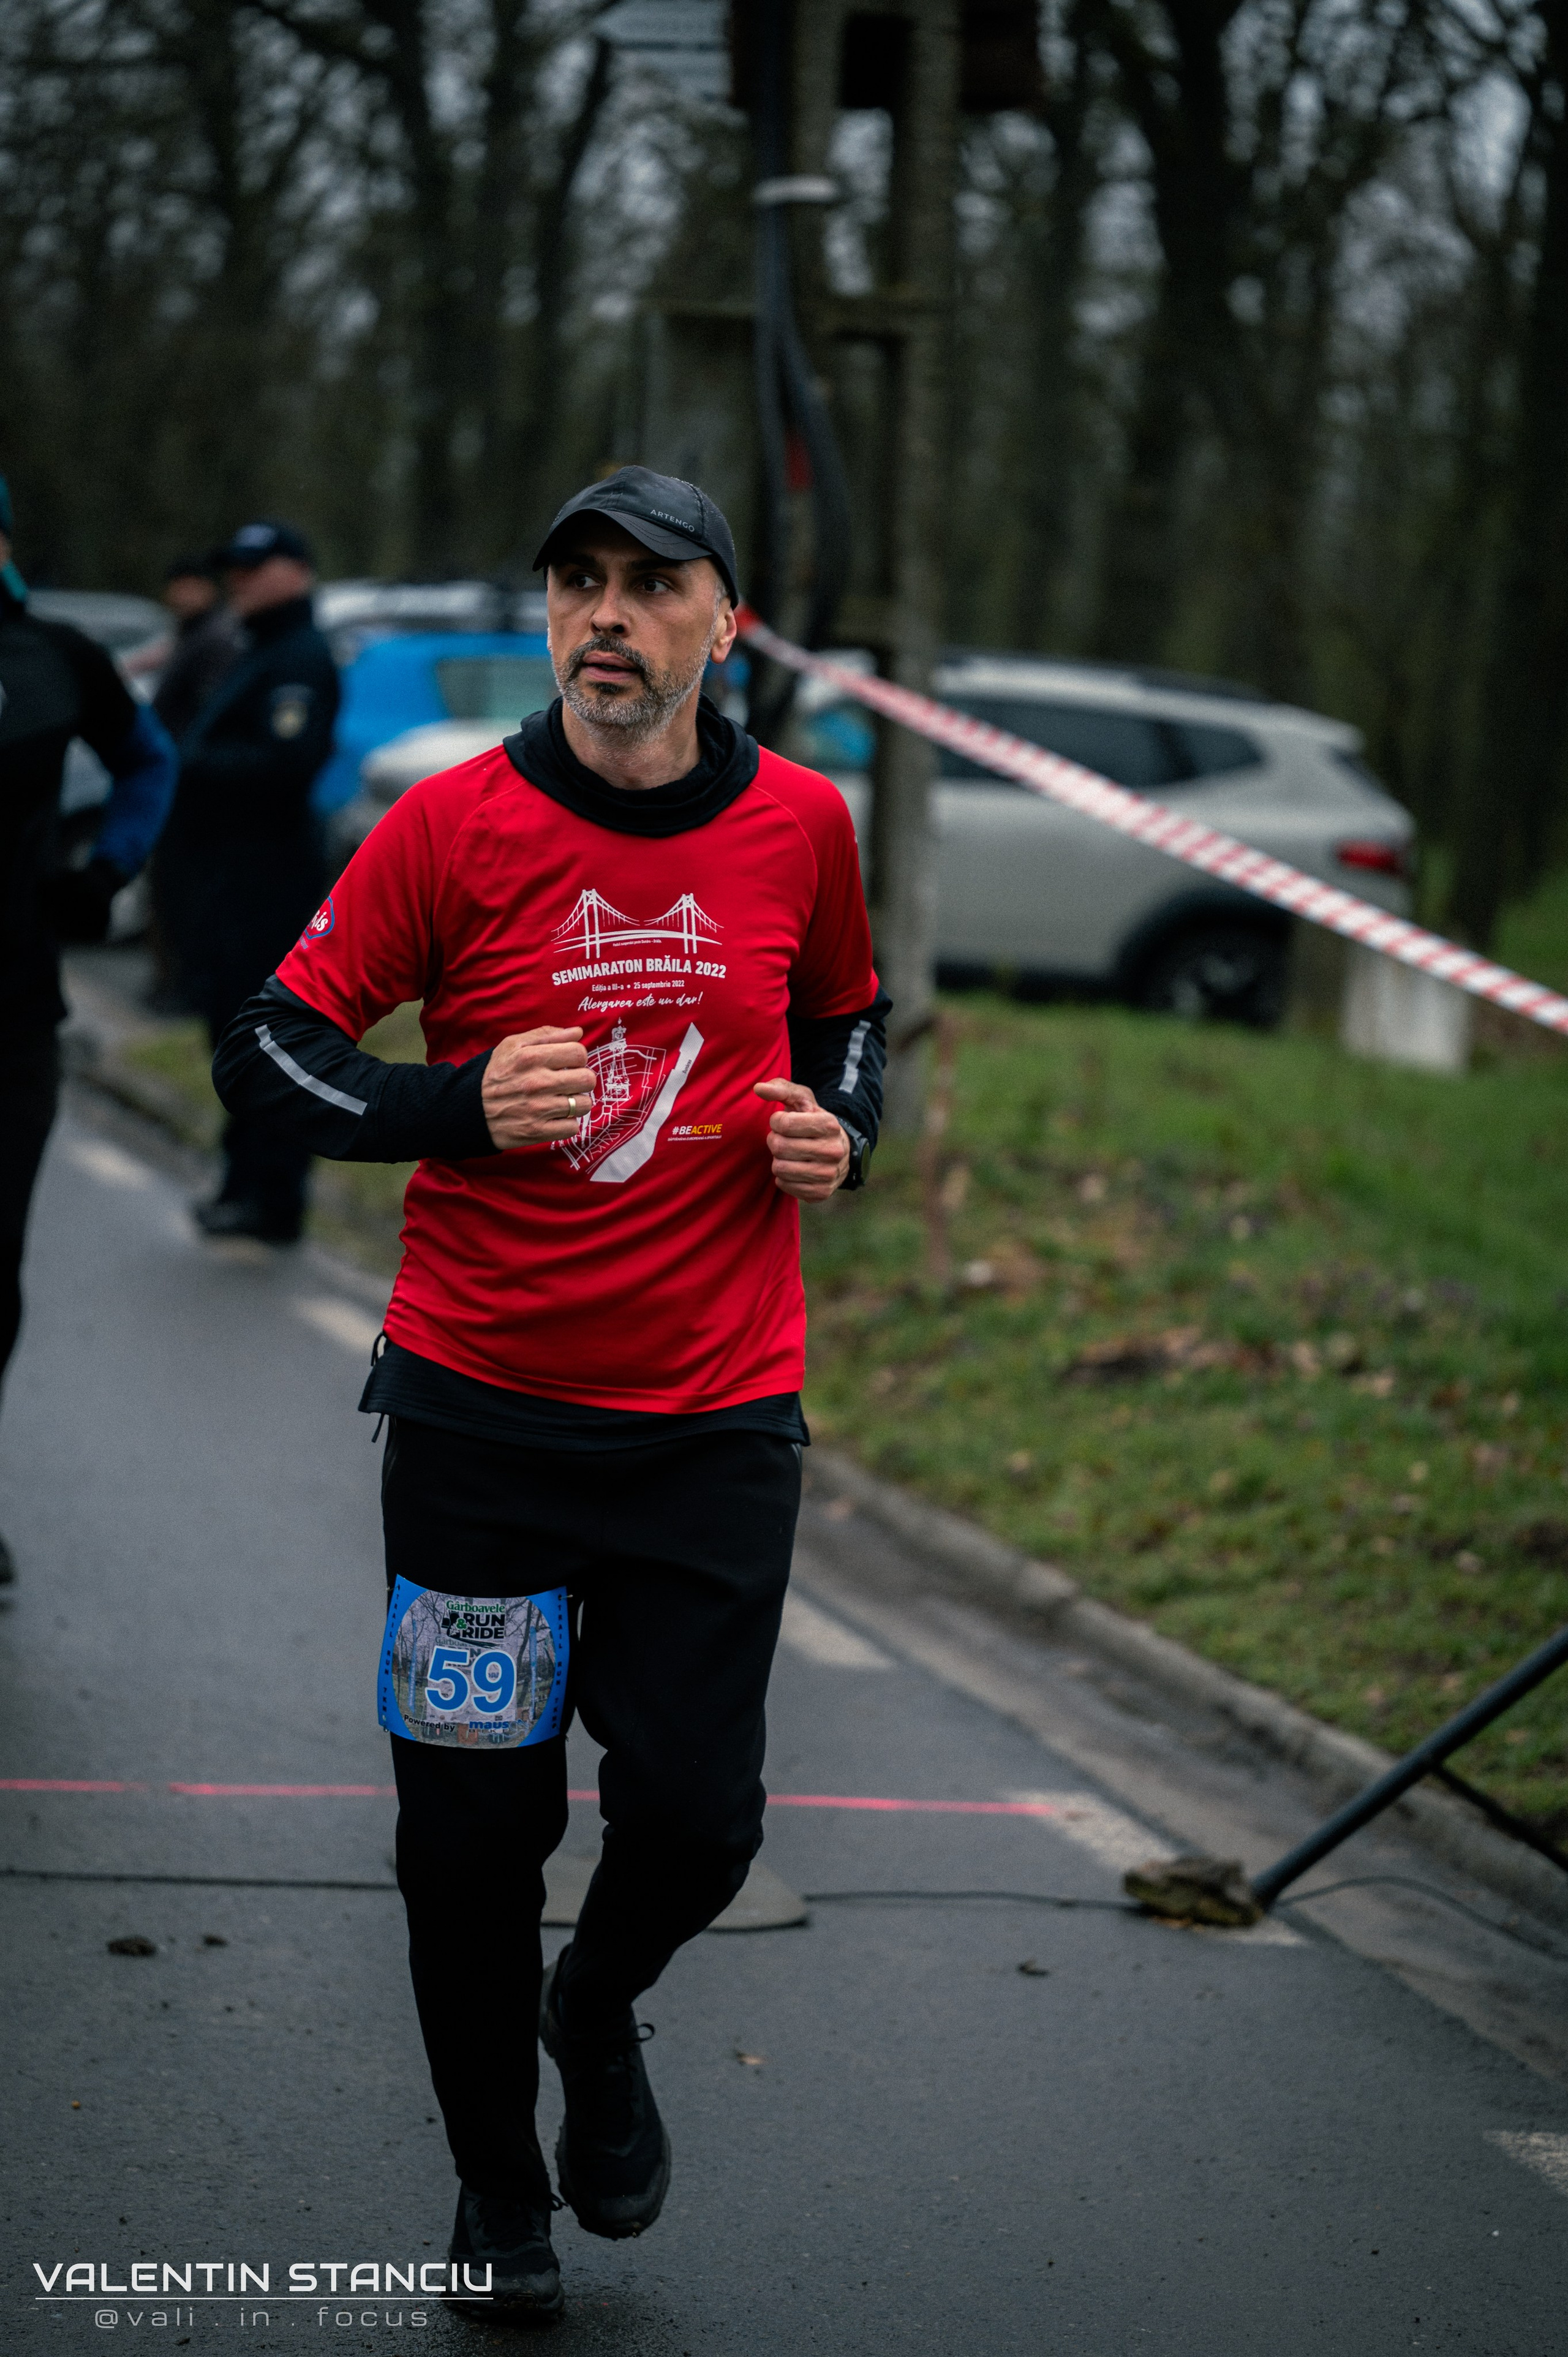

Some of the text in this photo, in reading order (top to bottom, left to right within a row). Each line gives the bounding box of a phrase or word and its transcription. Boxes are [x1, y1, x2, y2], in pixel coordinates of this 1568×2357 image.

[650, 508, 695, 533] ARTENGO
[552, 955, 727, 986] SEMIMARATON BRĂILA 2022
[642, 980, 671, 990] septembrie
[578, 995, 634, 1013] Alergarea
[636, 993, 657, 1007] este
[676, 990, 704, 1006] dar!
[672, 1123, 723, 1135] #BEACTIVE
[446, 1599, 505, 1613] Gârboavele
[389, 1594, 399, 1638] TRAIL
[467, 1613, 505, 1627] RUN
[456, 1618, 468, 1630] &
[462, 1627, 505, 1640] RIDE
[425, 1645, 517, 1714] 59
[404, 1714, 455, 1732] Powered by
[469, 1721, 509, 1730] maus
